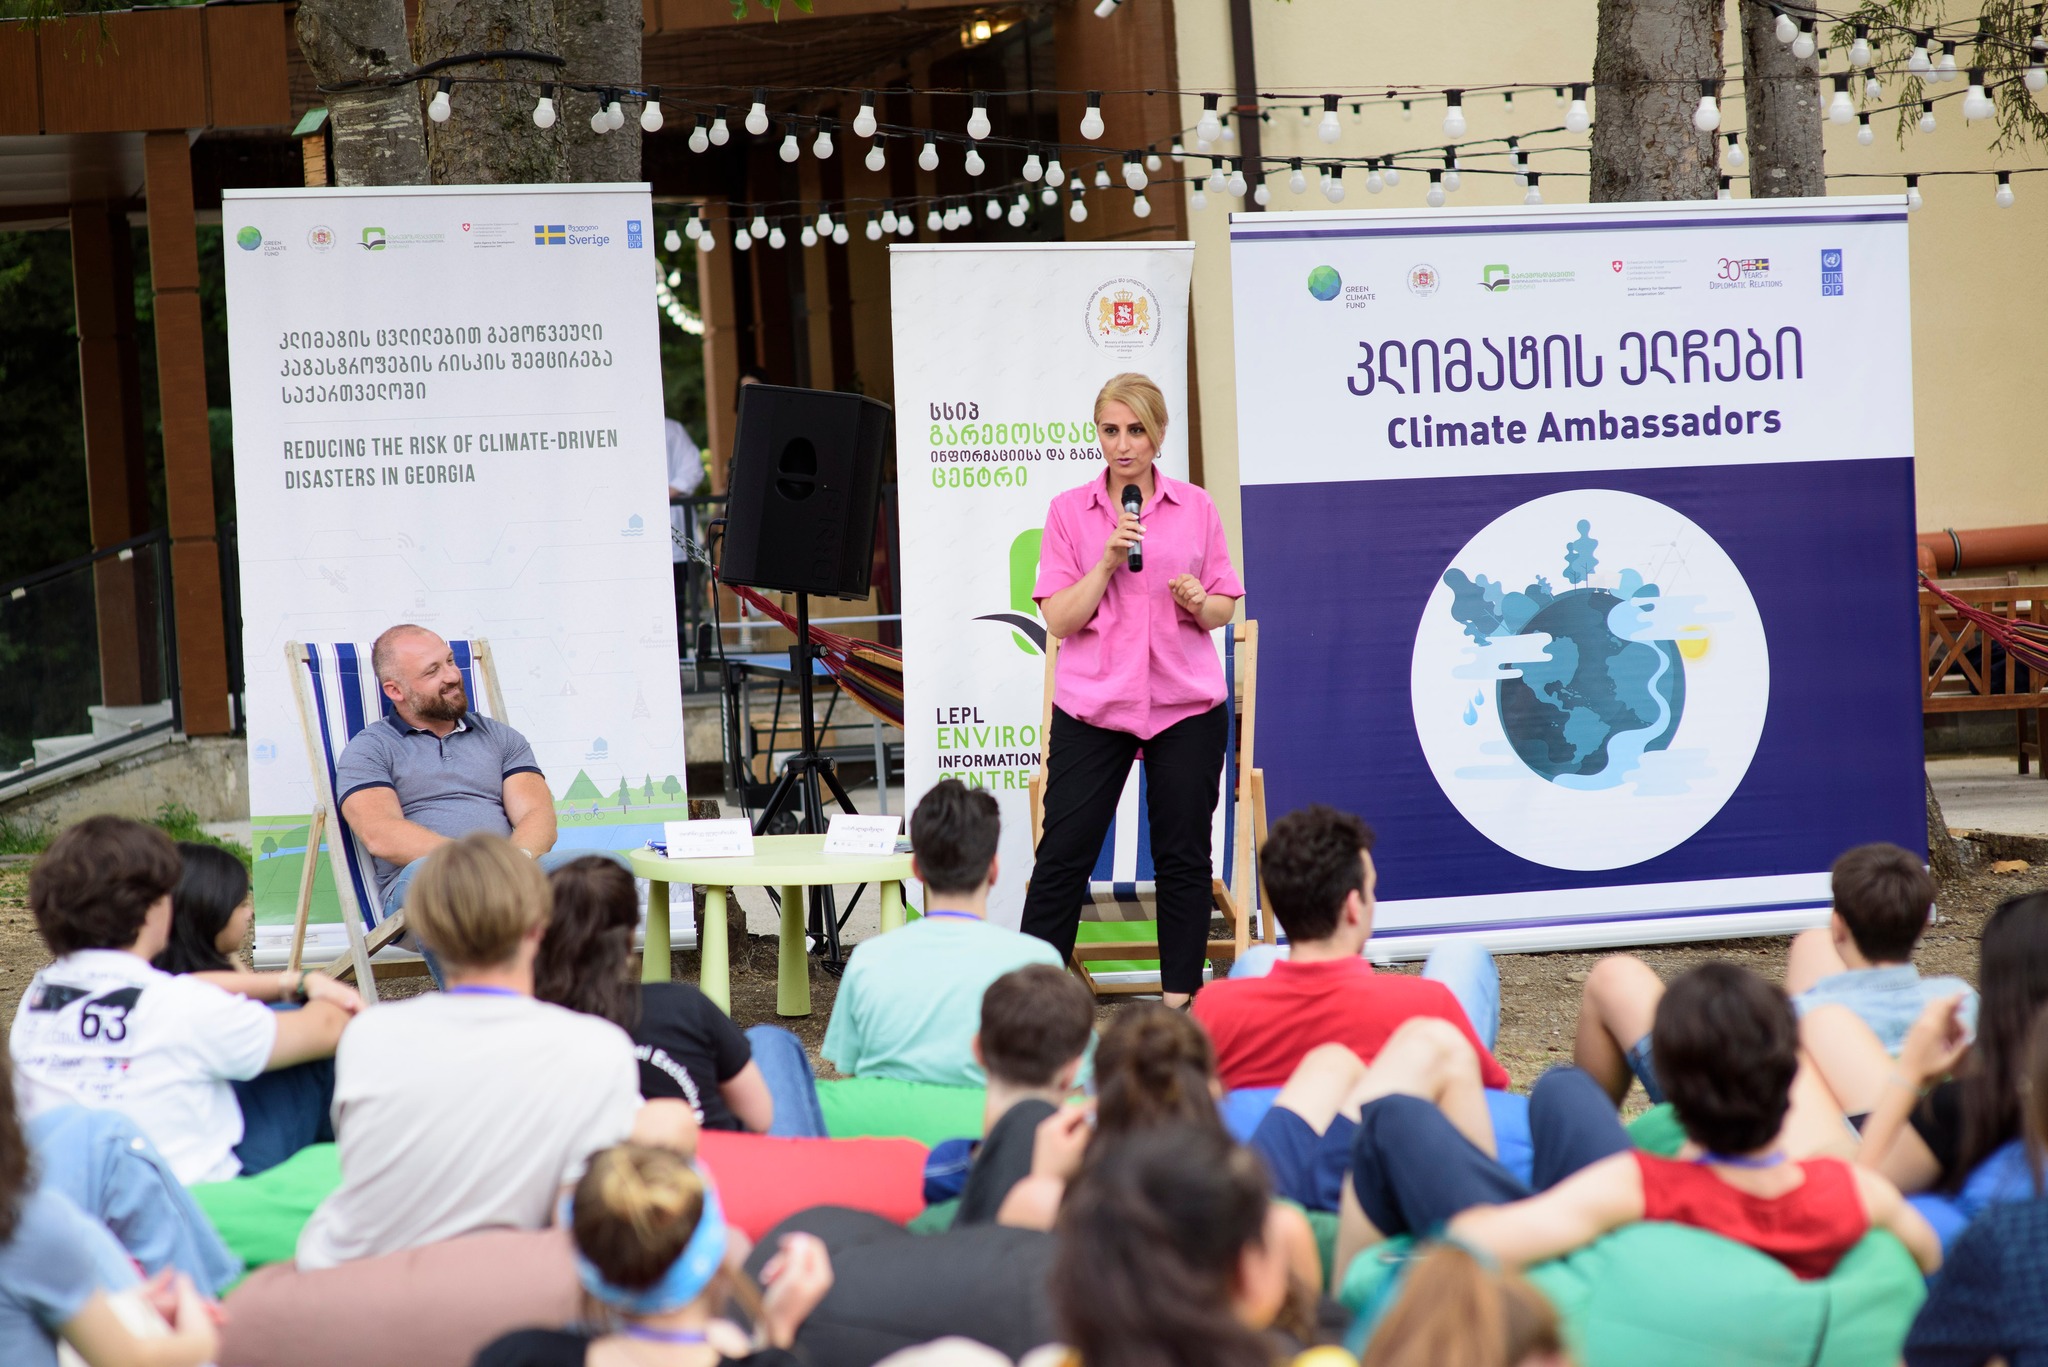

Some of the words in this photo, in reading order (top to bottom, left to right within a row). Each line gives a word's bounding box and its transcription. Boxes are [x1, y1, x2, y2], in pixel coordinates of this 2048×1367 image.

[568, 234, 610, 247] Sverige
[1717, 258, 1741, 281] 30
[1823, 273, 1842, 283] UN
[1823, 285, 1842, 295] DP
[279, 329, 370, 350] კლიმატის
[376, 325, 482, 347] ცვლილებით
[488, 323, 603, 345] გამოწვეული
[281, 353, 432, 378] კატასტროფების
[438, 351, 506, 374] რისკის
[512, 348, 614, 371] შემცირება
[1346, 333, 1604, 397] კლიმატის
[1620, 325, 1804, 386] ელჩები
[282, 380, 426, 405] საქართველოში
[930, 402, 980, 421] სსიპ
[930, 421, 1097, 446] გარემოსდაც
[1387, 409, 1527, 450] Climate
[1537, 404, 1782, 444] Ambassadors
[284, 439, 366, 460] REDUCING
[371, 437, 403, 457] THE
[410, 435, 448, 456] RISK
[454, 433, 473, 454] OF
[479, 429, 619, 453] CLIMATE-DRIVEN
[931, 449, 1041, 463] ინფორმაციისა
[1046, 448, 1065, 461] და
[285, 467, 375, 490] DISASTERS
[382, 466, 399, 486] IN
[405, 463, 475, 485] GEORGIA
[932, 465, 1028, 488] ცენტრი
[936, 707, 984, 724] LEPL
[938, 725, 1042, 749] ENVIRO
[938, 753, 1040, 768] INFORMATION
[81, 1001, 126, 1041] 63
